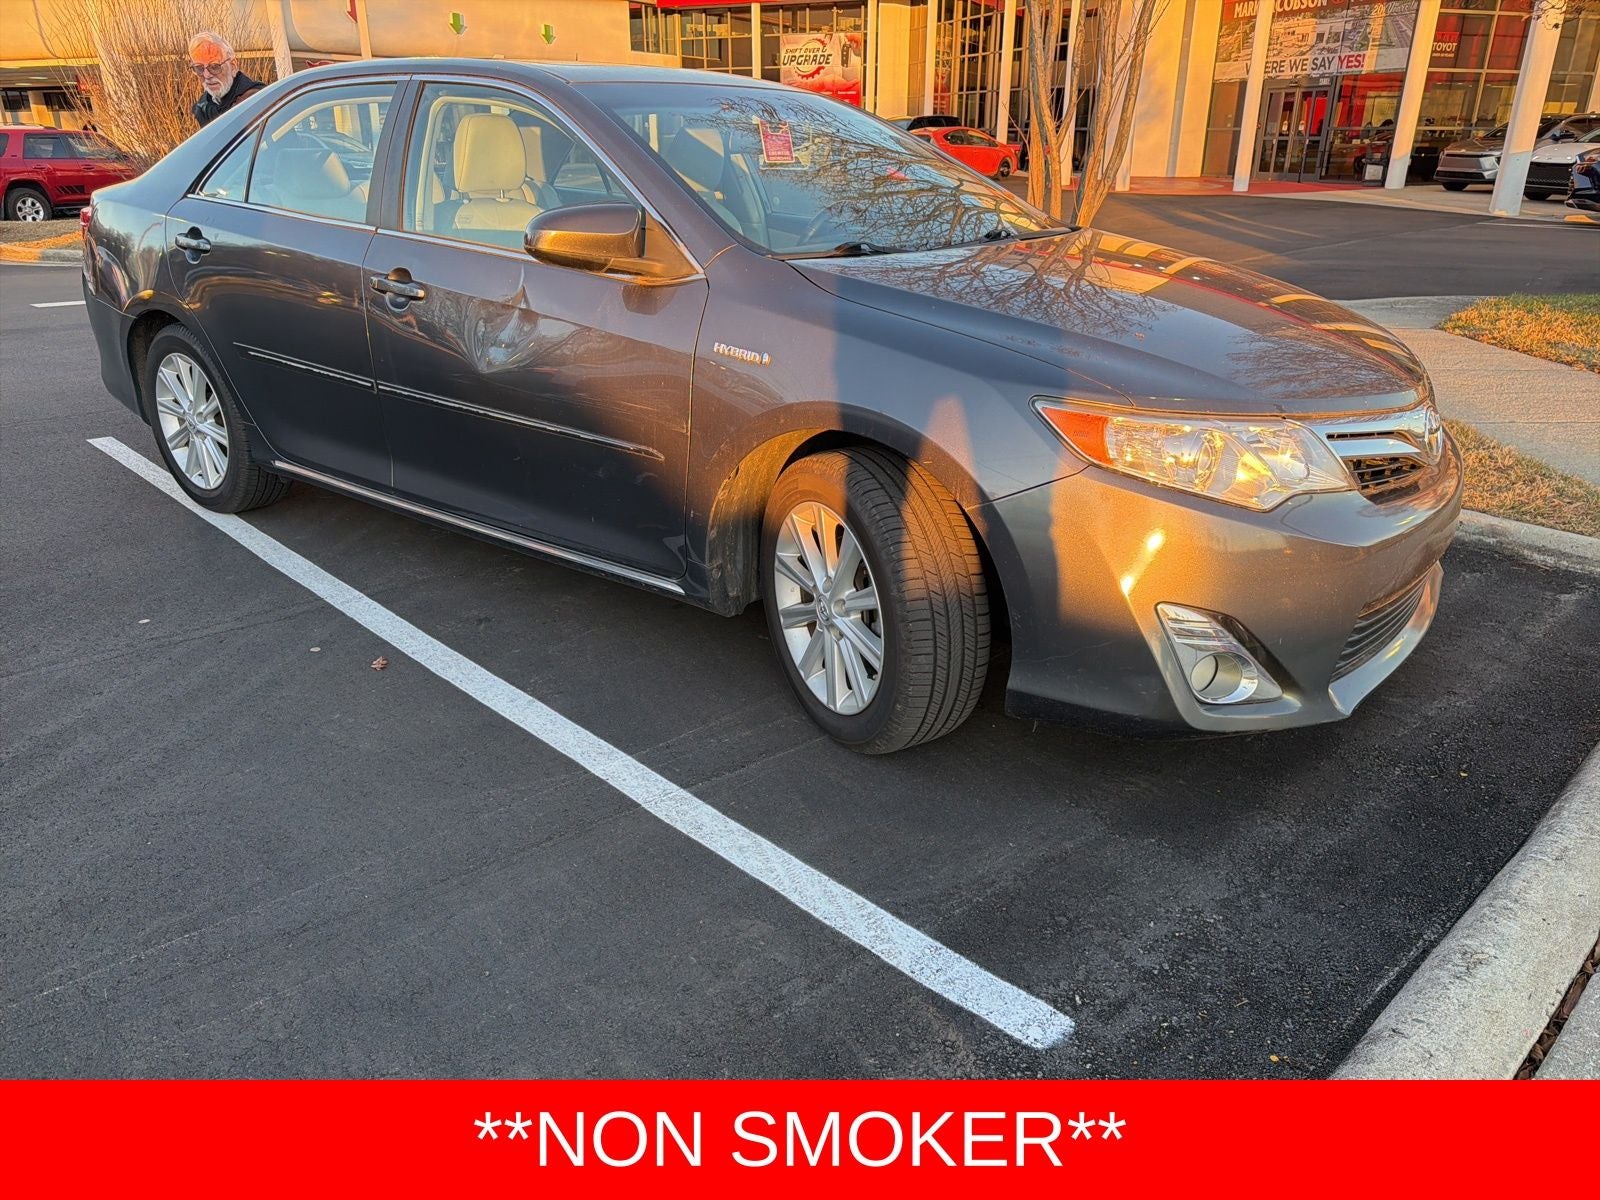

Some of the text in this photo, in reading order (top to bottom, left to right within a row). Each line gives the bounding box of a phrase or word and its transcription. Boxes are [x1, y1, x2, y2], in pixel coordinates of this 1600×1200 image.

[782, 54, 832, 66] UPGRADE
[1289, 58, 1309, 73] WE
[1311, 56, 1335, 71] SAY
[1338, 53, 1366, 69] YES!
[713, 342, 760, 362] HYBRID
